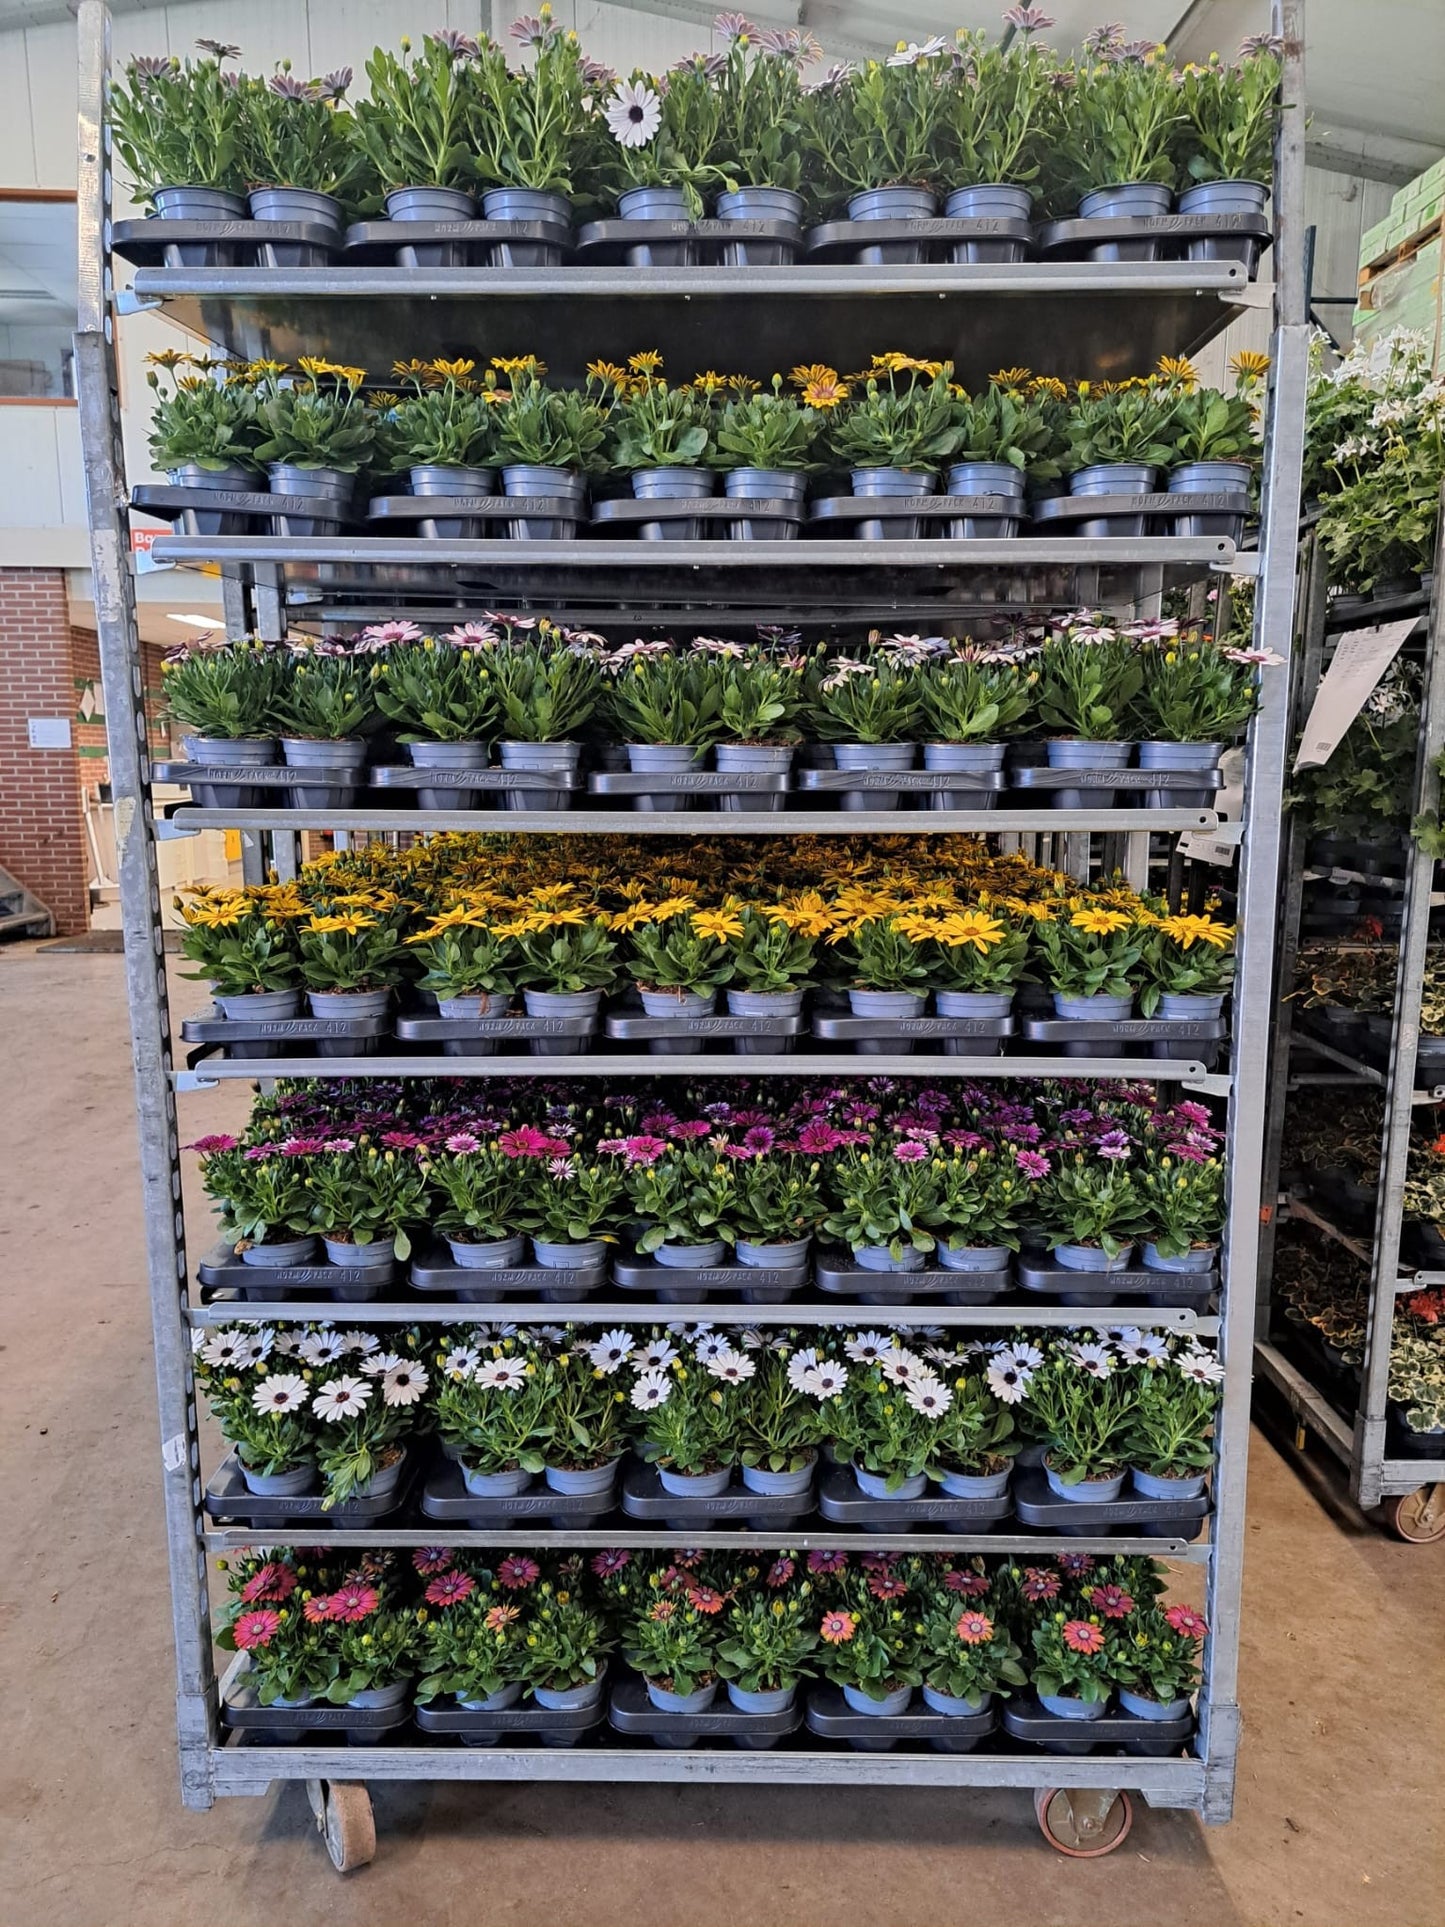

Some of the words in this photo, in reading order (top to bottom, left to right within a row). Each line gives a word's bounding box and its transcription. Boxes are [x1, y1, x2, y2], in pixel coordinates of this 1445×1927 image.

[326, 1021, 346, 1034] 412
[543, 1020, 563, 1032] 412
[752, 1019, 771, 1032] 412
[965, 1021, 985, 1033] 412
[1178, 1023, 1200, 1036] 412
[340, 1270, 360, 1282] 412
[555, 1271, 574, 1284] 412
[760, 1271, 779, 1283] 412
